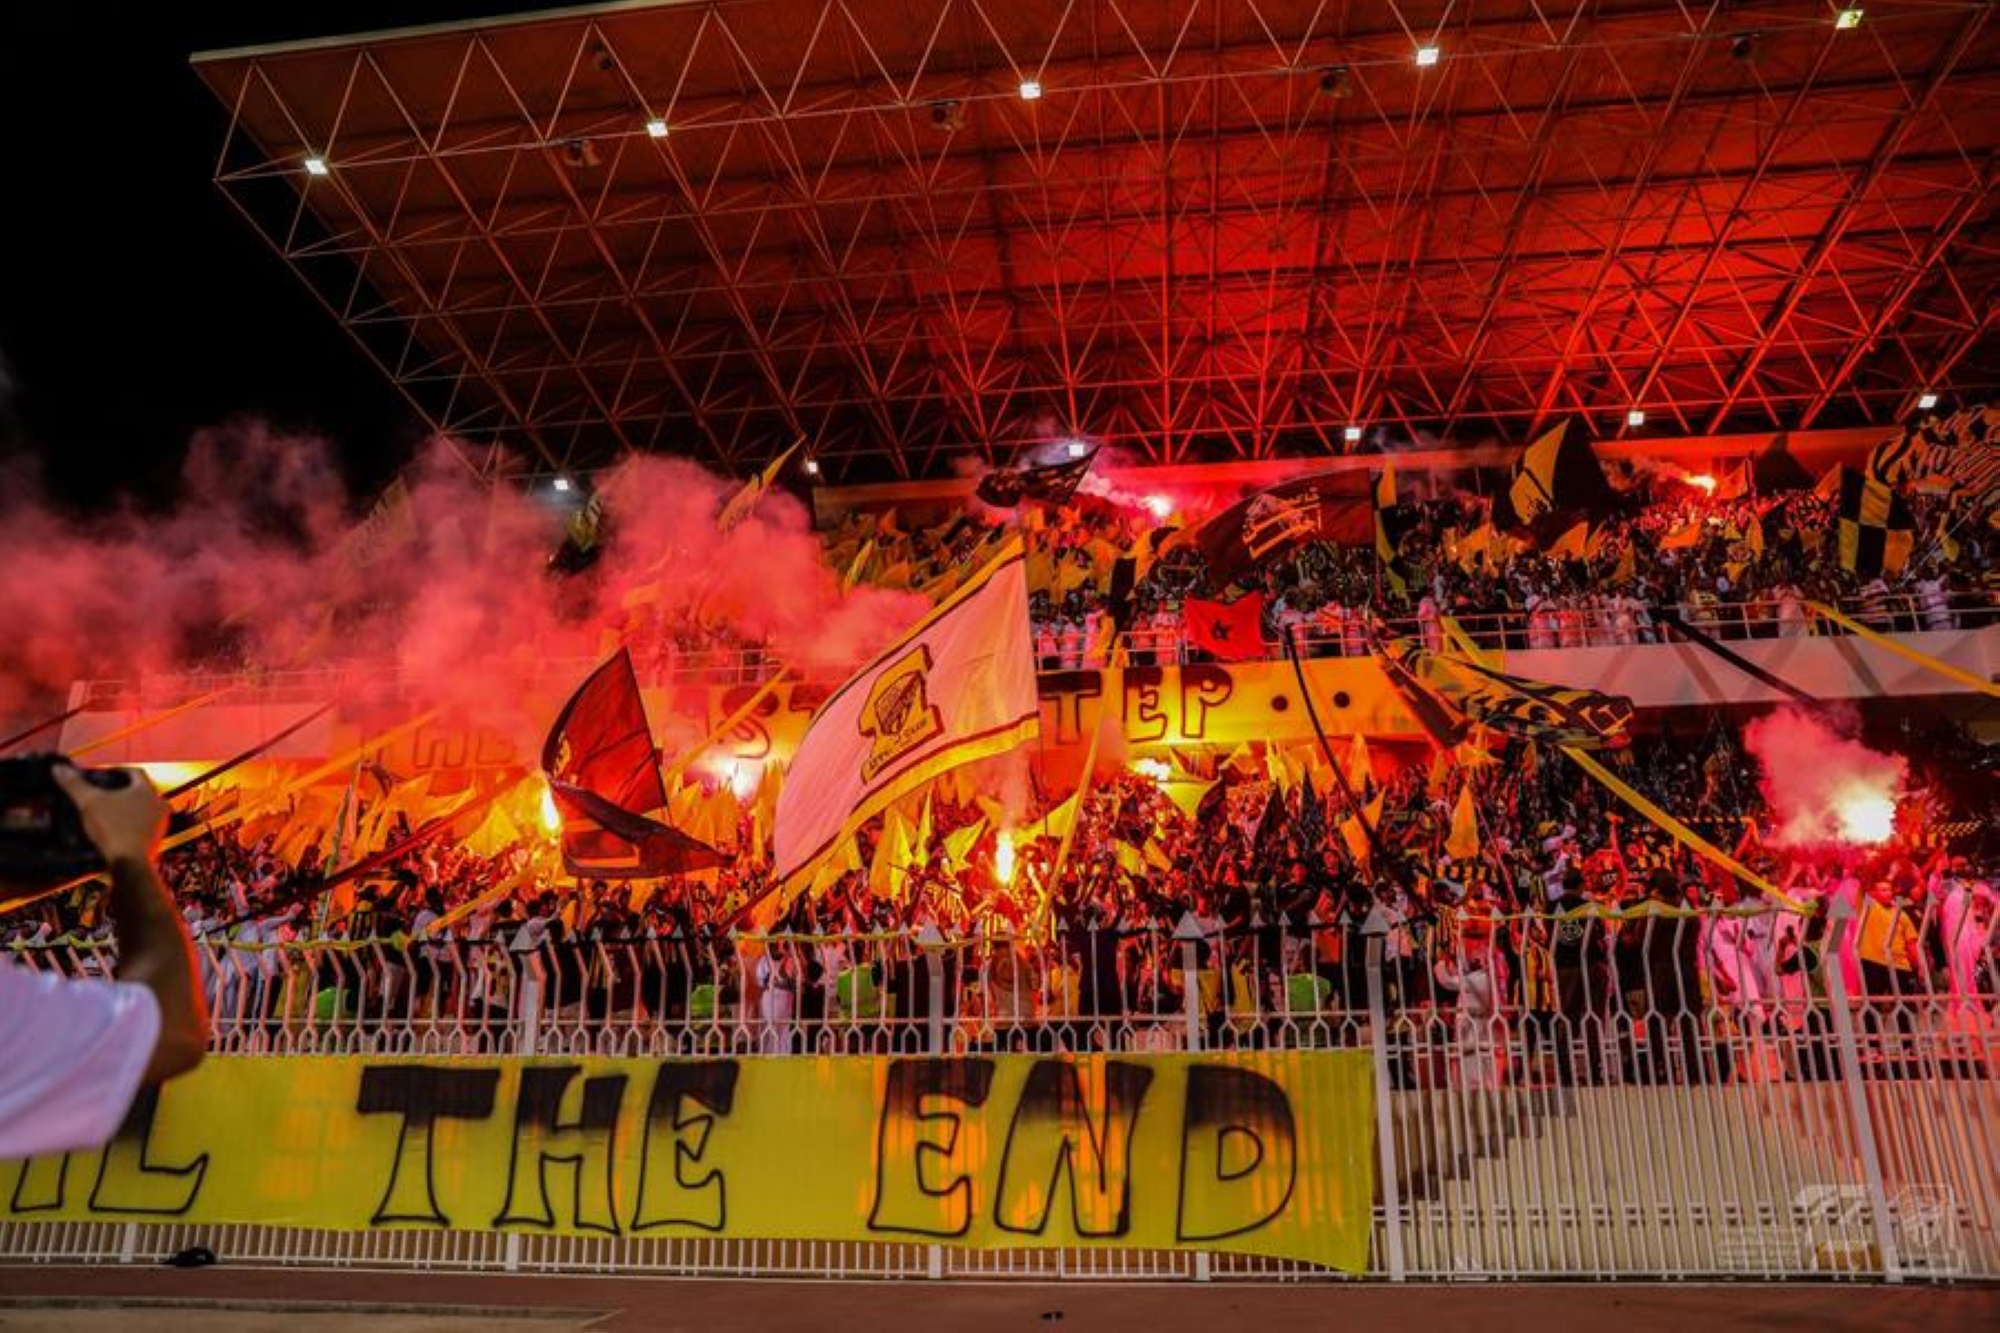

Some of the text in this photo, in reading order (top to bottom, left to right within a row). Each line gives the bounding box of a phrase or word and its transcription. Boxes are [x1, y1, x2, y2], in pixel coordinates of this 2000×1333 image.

[1037, 664, 1232, 745] TEP
[356, 1060, 740, 1236] THE
[866, 1057, 1298, 1242] END
